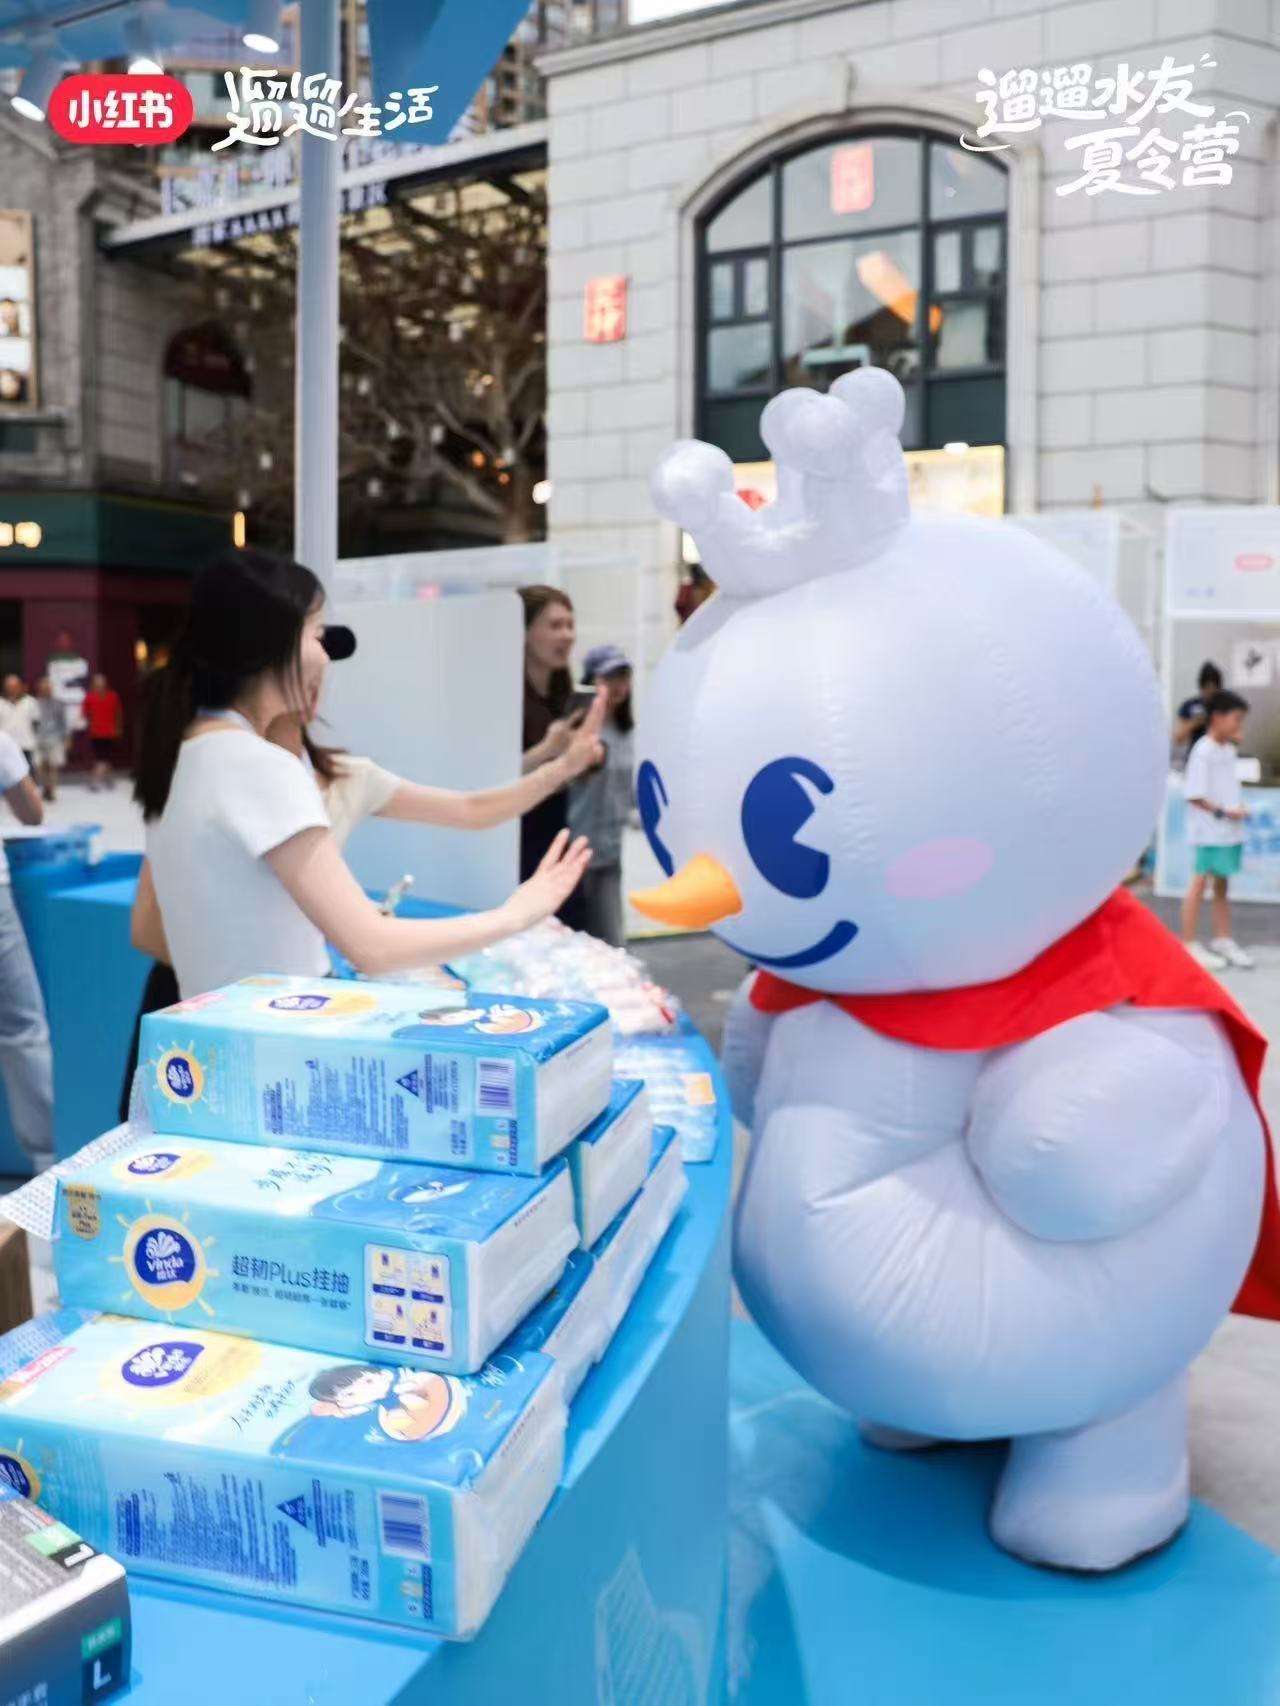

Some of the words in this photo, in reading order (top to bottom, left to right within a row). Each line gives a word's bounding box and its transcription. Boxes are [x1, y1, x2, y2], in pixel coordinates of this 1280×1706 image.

[231, 1254, 350, 1294] 超韧Plus挂抽
[92, 1658, 113, 1691] L
